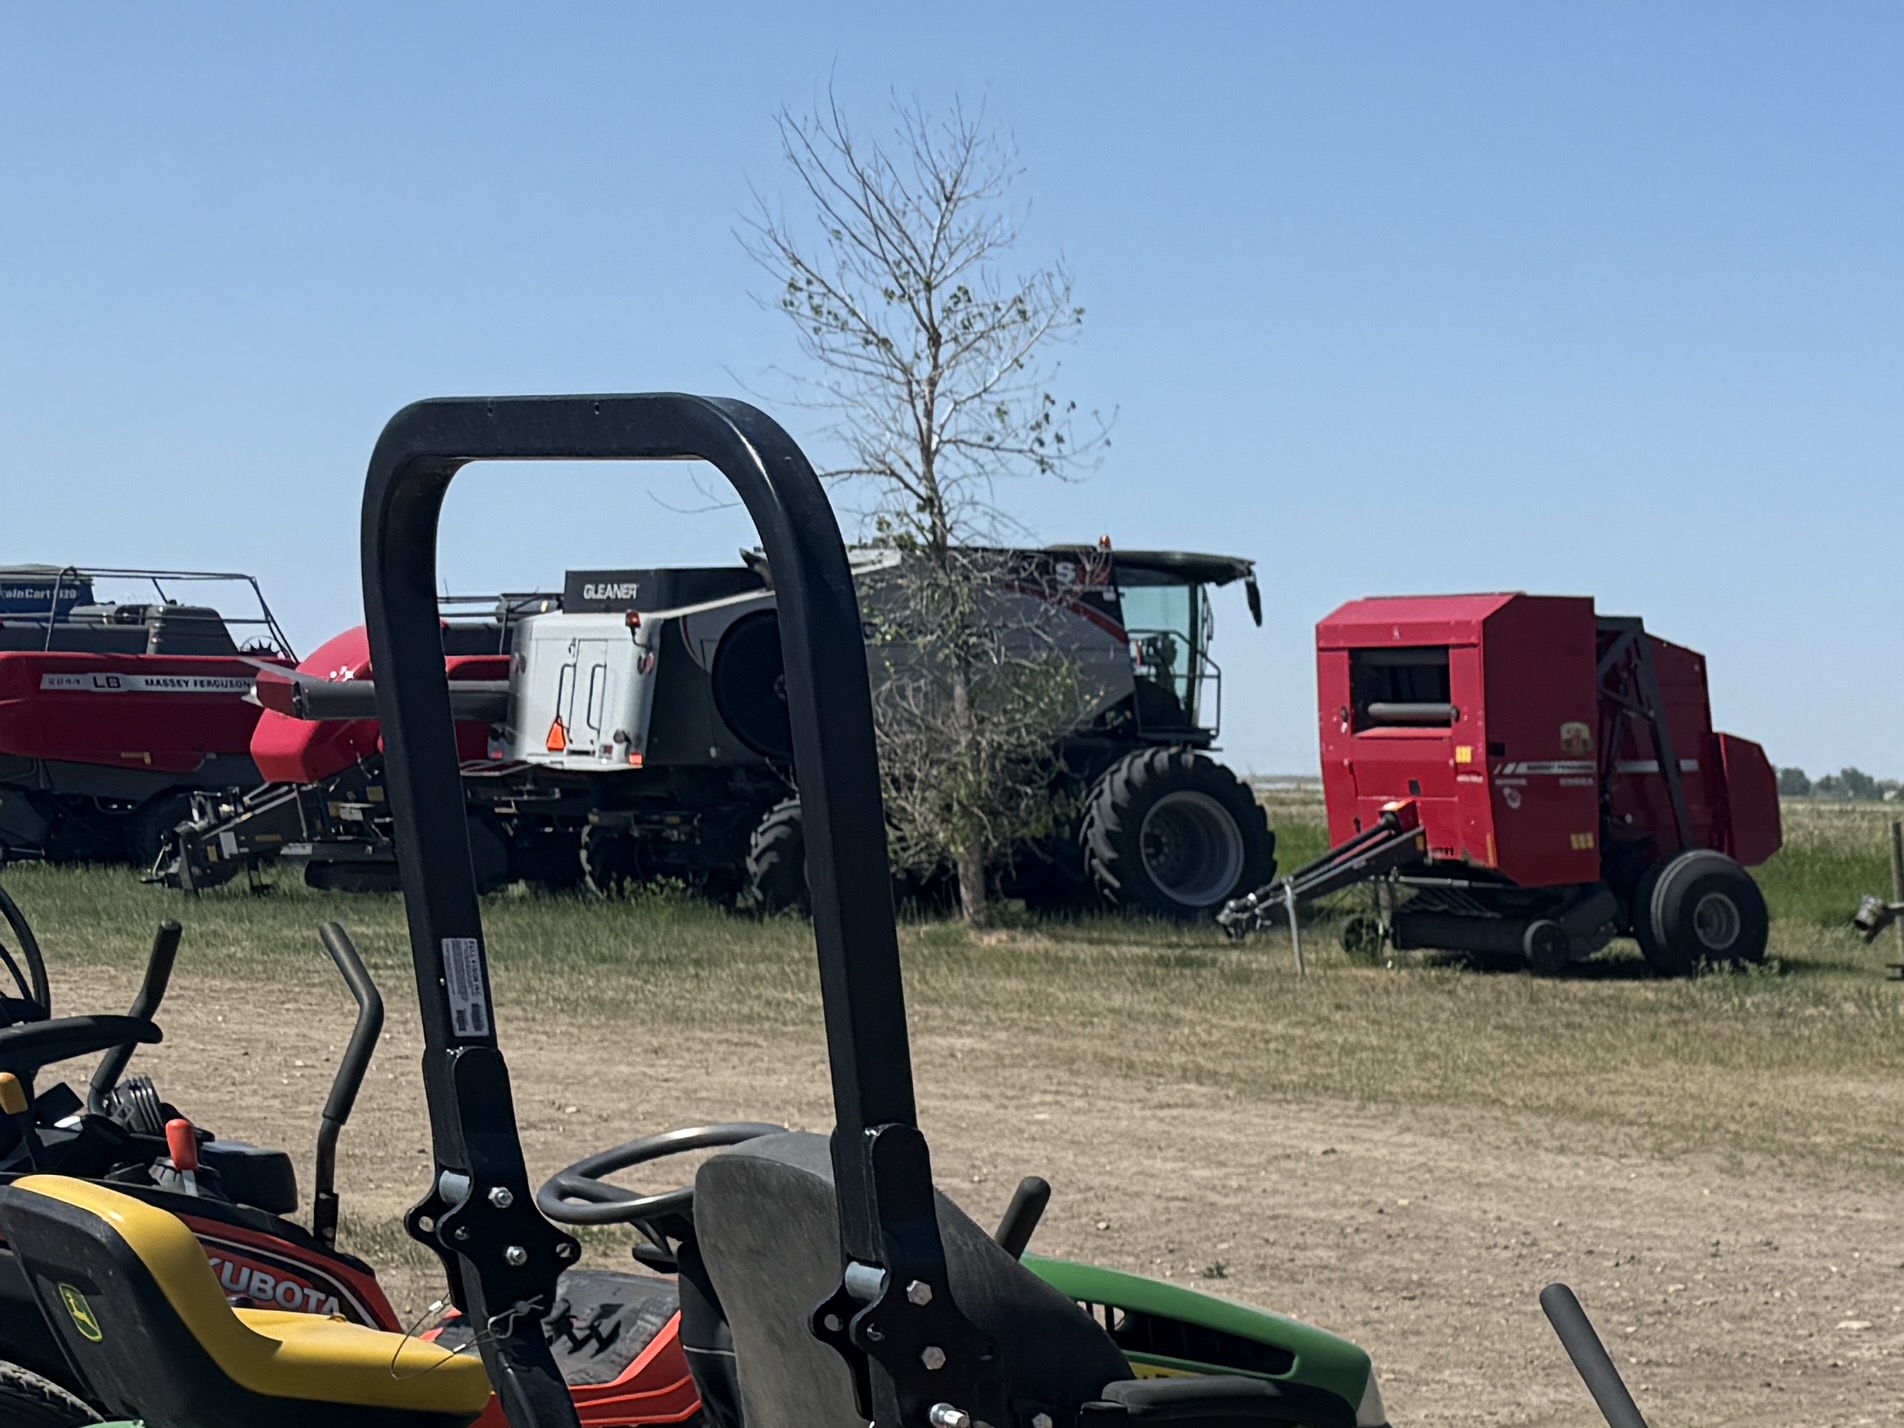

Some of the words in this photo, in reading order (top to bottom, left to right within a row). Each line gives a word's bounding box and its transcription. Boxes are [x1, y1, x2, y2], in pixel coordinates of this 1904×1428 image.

[583, 583, 637, 600] GLEANER
[93, 675, 121, 689] LB
[145, 678, 189, 688] MASSEY
[193, 677, 250, 689] FERGUSON
[209, 1257, 340, 1315] UBOTA
